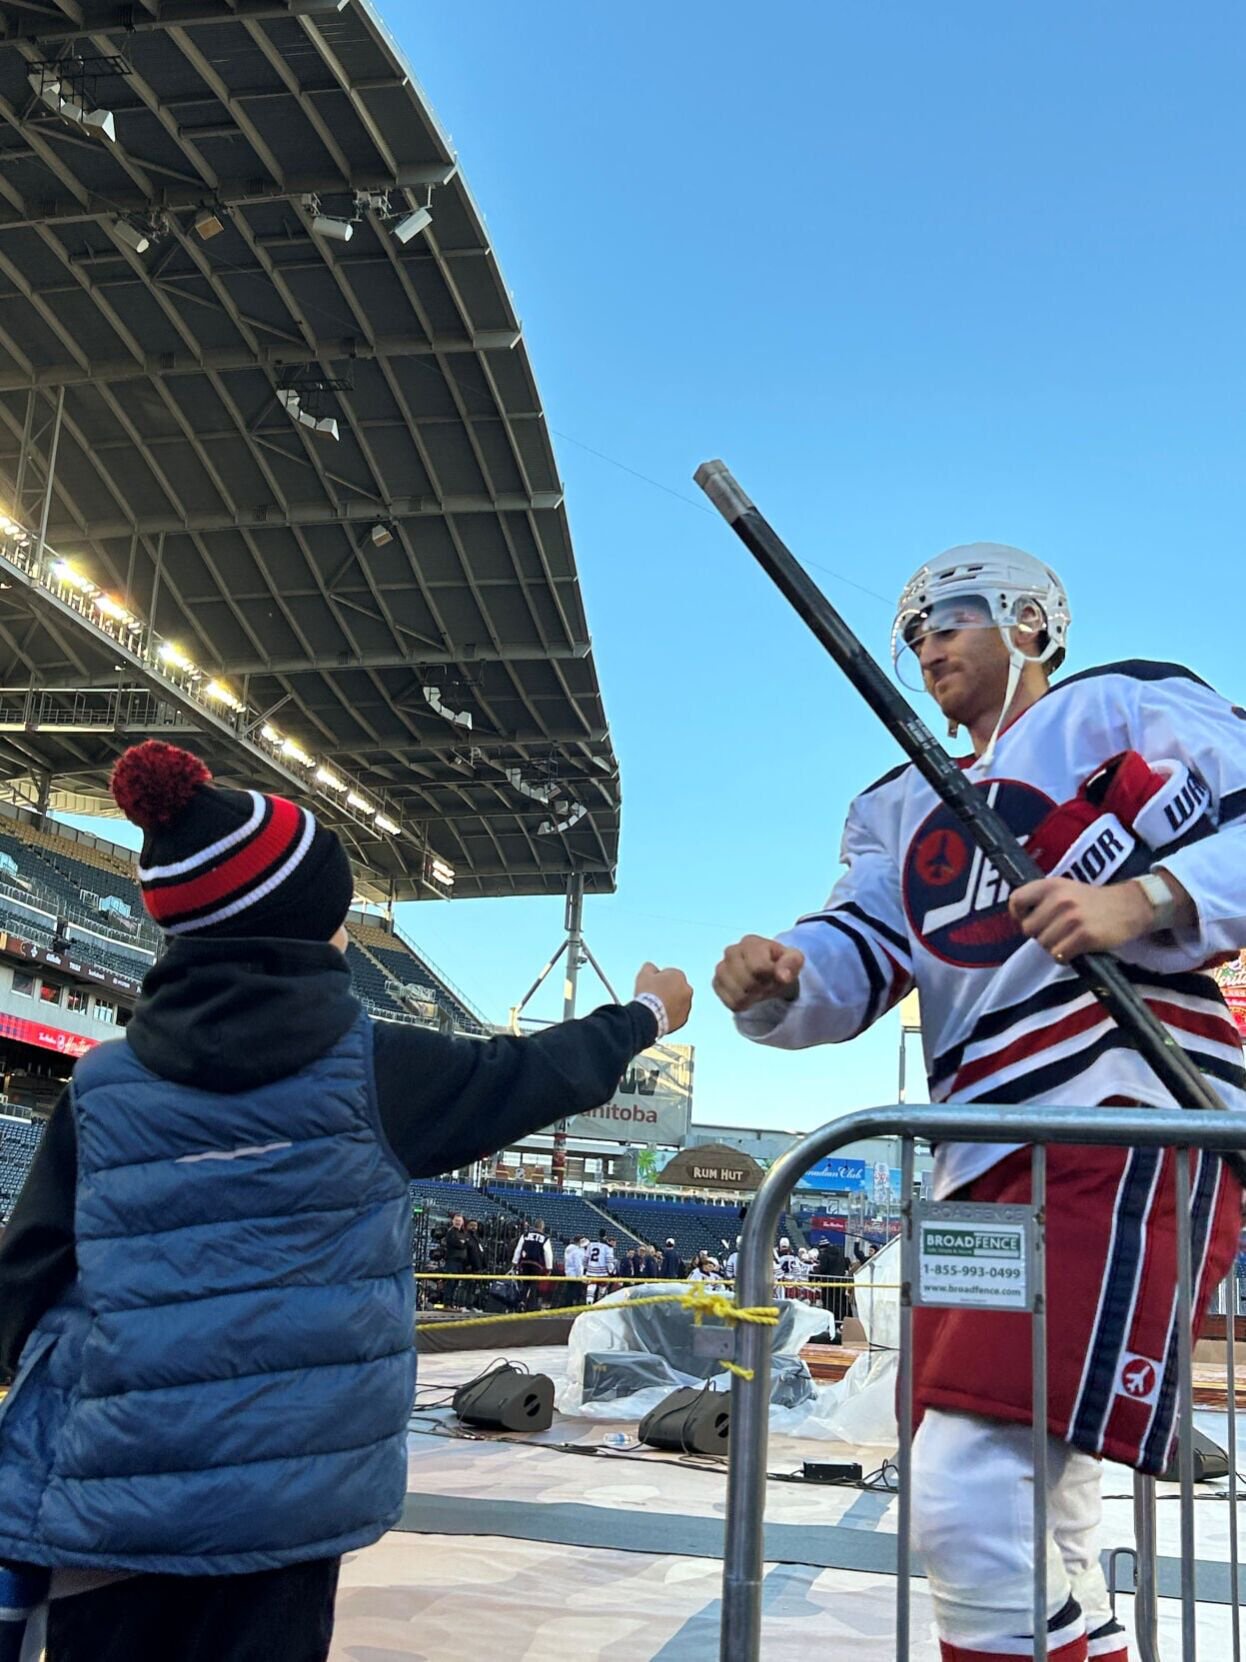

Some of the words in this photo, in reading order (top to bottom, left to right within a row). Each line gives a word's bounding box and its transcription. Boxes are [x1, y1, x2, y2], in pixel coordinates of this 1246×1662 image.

[693, 1166, 718, 1180] RUM
[720, 1168, 744, 1182] HUT
[838, 1165, 864, 1179] Club
[524, 1232, 545, 1243] JETS
[926, 1234, 1017, 1249] BROADFENCE
[590, 1247, 600, 1262] 2
[923, 1263, 1021, 1279] 1-855-993-0499
[923, 1284, 1021, 1297] www.broadfence.com
